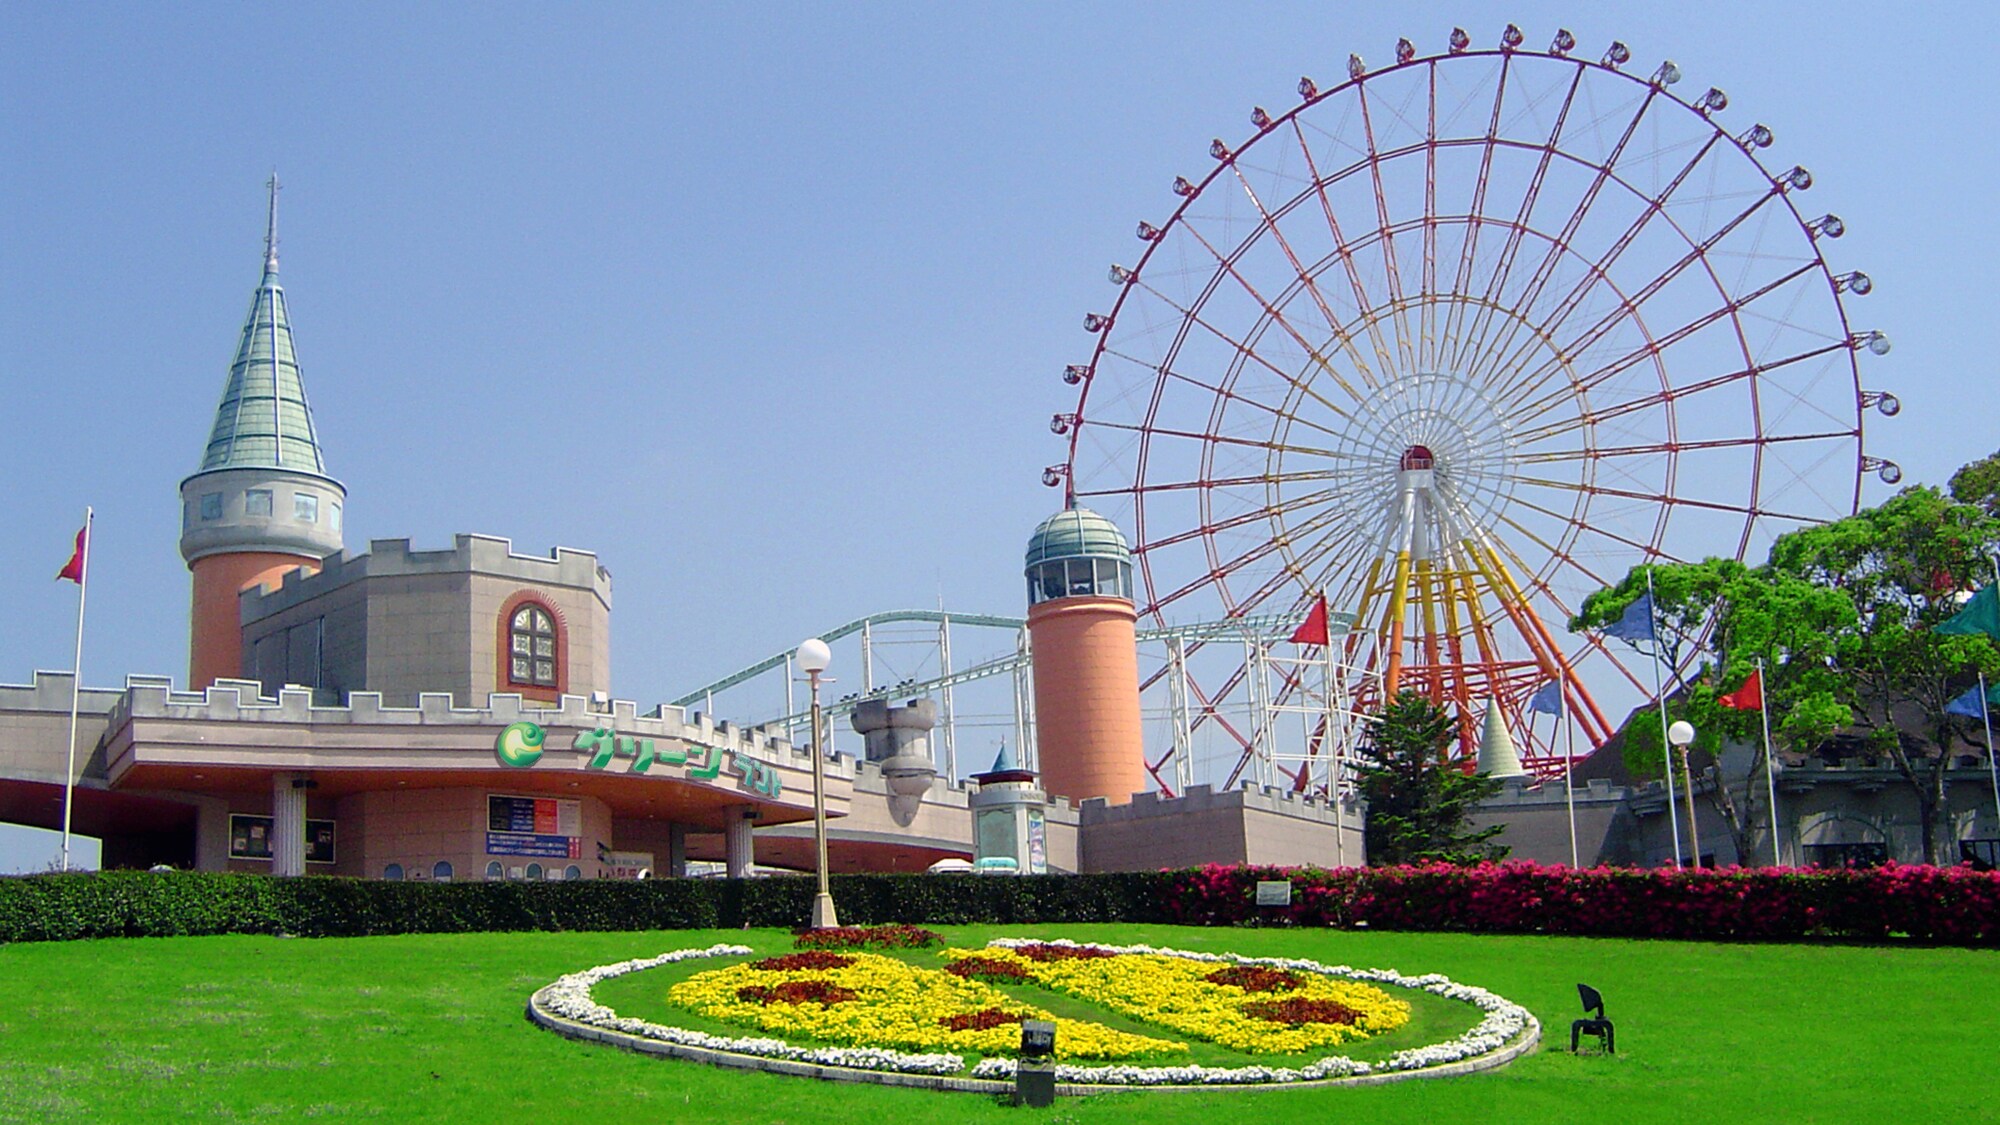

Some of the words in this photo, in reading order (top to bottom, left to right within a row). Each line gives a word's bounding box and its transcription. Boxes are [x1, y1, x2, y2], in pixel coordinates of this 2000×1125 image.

[574, 727, 783, 799] グリーンランド
